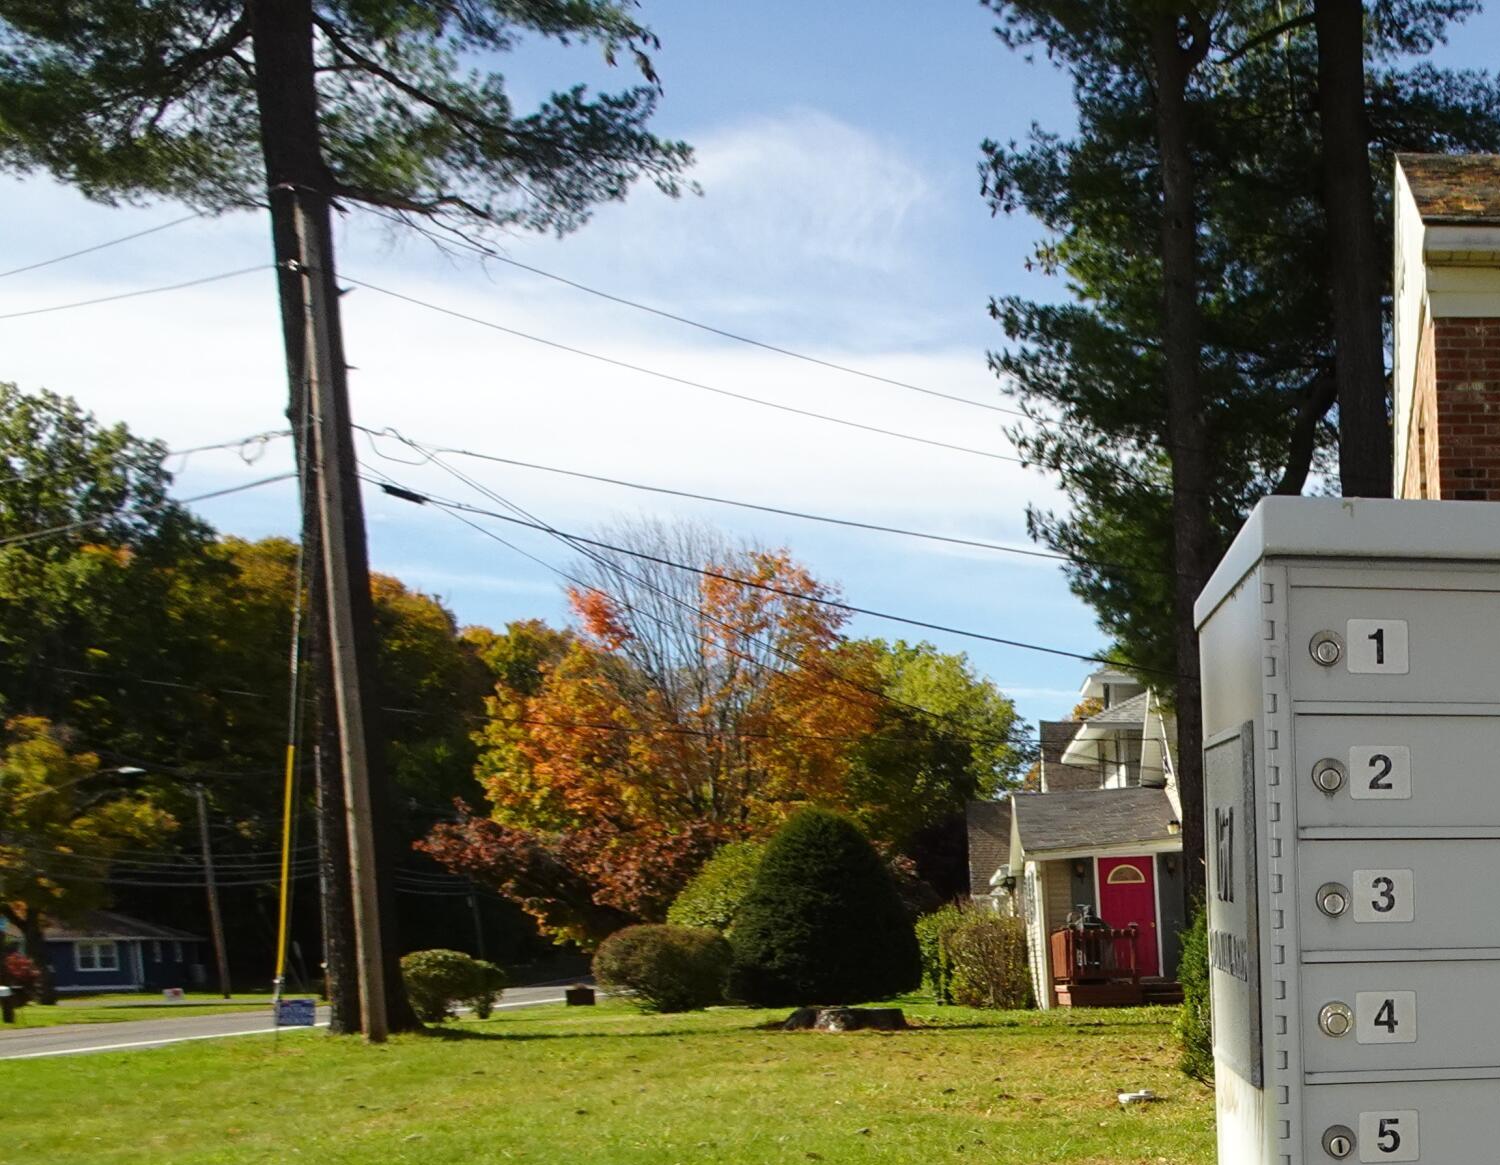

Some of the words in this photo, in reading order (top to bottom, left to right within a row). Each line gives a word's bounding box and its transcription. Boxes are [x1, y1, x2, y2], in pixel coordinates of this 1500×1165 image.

[1368, 628, 1384, 665] 1
[1368, 754, 1393, 790] 2
[1371, 876, 1395, 913] 3
[1374, 999, 1399, 1034] 4
[1377, 1118, 1401, 1153] 5
